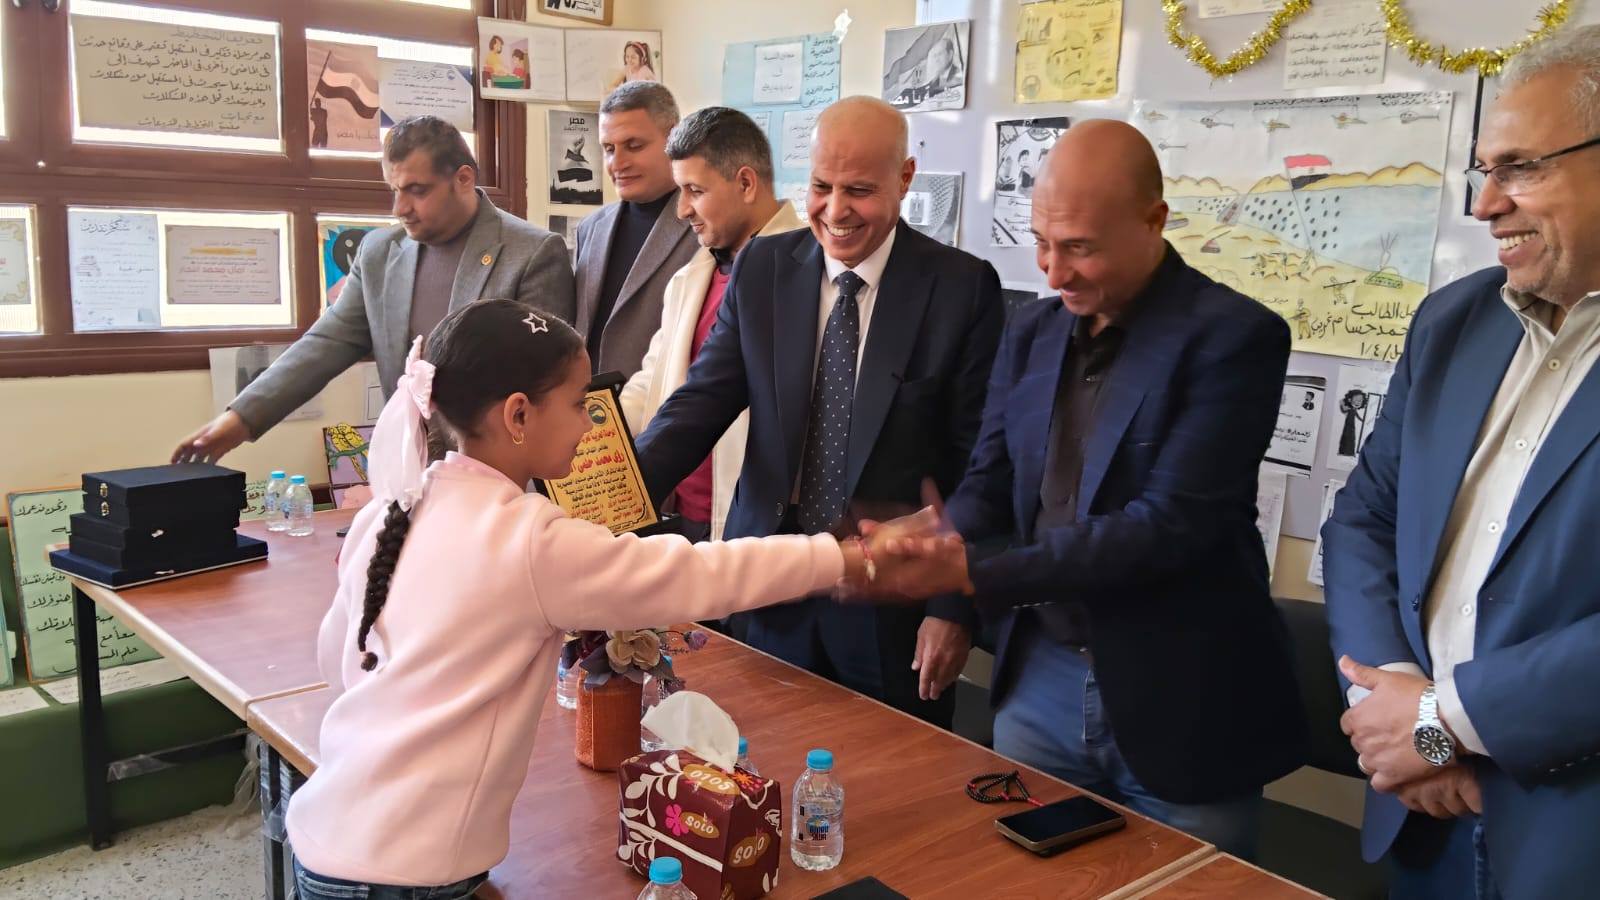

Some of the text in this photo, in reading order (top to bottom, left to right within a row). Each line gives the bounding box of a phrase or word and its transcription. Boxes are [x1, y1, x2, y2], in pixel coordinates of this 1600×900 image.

[569, 117, 585, 126] مصر
[1351, 301, 1401, 319] الطالب
[1376, 323, 1410, 336] حمد
[690, 769, 735, 791] SOLO
[685, 815, 714, 834] SOLO
[733, 836, 765, 865] SOLO
